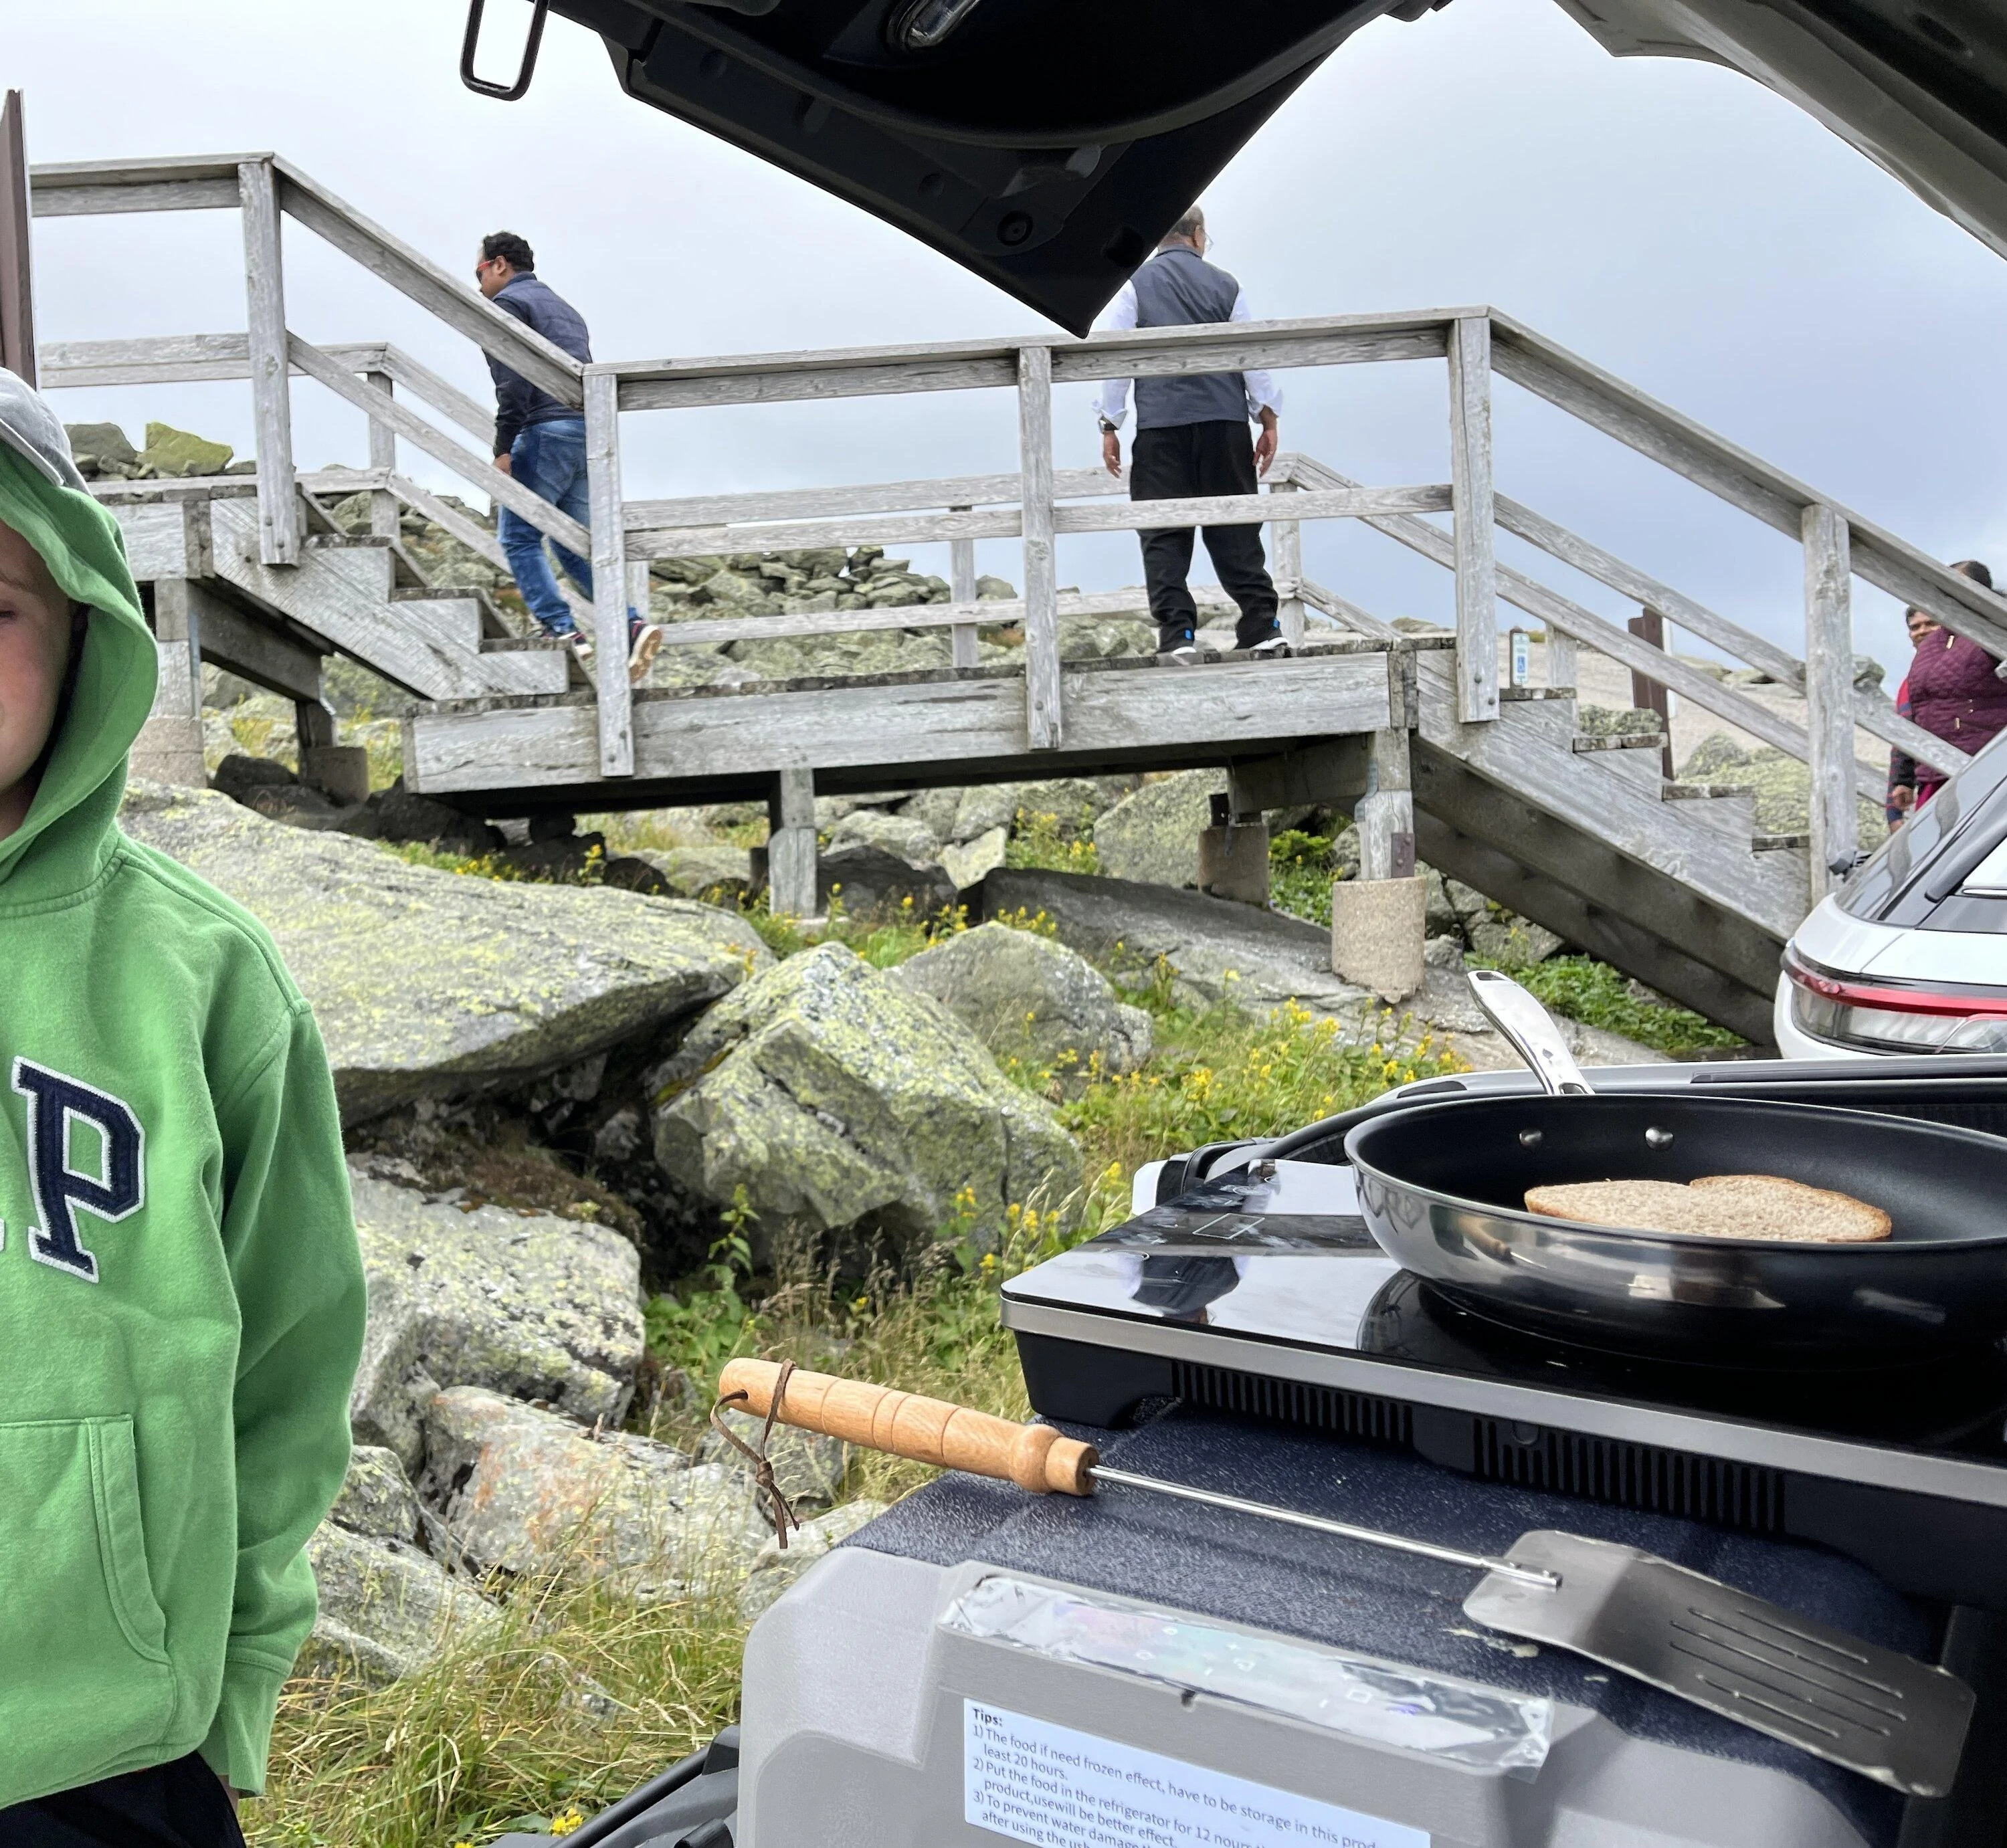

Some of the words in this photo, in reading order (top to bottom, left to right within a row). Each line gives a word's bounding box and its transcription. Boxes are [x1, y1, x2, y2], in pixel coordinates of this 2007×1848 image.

[0, 1055, 146, 1284] P
[973, 1708, 1002, 1727] Tips:
[984, 1743, 1011, 1764] least
[1014, 1754, 1028, 1768] 20
[1031, 1758, 1068, 1780] hours.
[973, 1725, 983, 1738] 1)
[986, 1728, 1008, 1746] The
[1010, 1734, 1036, 1753] food
[1040, 1744, 1048, 1756] if
[1051, 1750, 1080, 1767] need
[1084, 1757, 1122, 1779] frozen
[1126, 1772, 1165, 1795] effect,
[1169, 1781, 1200, 1803] have
[1204, 1793, 1217, 1808] to
[1221, 1797, 1237, 1814] be
[1241, 1806, 1291, 1831] storage
[1295, 1820, 1308, 1835] in
[1312, 1825, 1338, 1845] this
[1342, 1836, 1378, 1848] prod
[973, 1758, 983, 1772] 2)
[987, 1762, 1006, 1778] Put
[1009, 1769, 1028, 1784] the
[1031, 1775, 1058, 1794] food
[1061, 1785, 1072, 1799] in
[1076, 1790, 1096, 1806] the
[1099, 1797, 1171, 1829] refrigerator
[1174, 1819, 1191, 1835] for
[1196, 1827, 1210, 1842] 12
[973, 1791, 983, 1805] 3)
[987, 1794, 1000, 1809] To
[1004, 1802, 1048, 1825] prevent
[1052, 1816, 1086, 1836] water
[982, 1811, 1009, 1828] after
[1012, 1821, 1044, 1843] using
[1047, 1831, 1066, 1847] the
[1079, 1807, 1094, 1823] be
[1098, 1813, 1135, 1835] better
